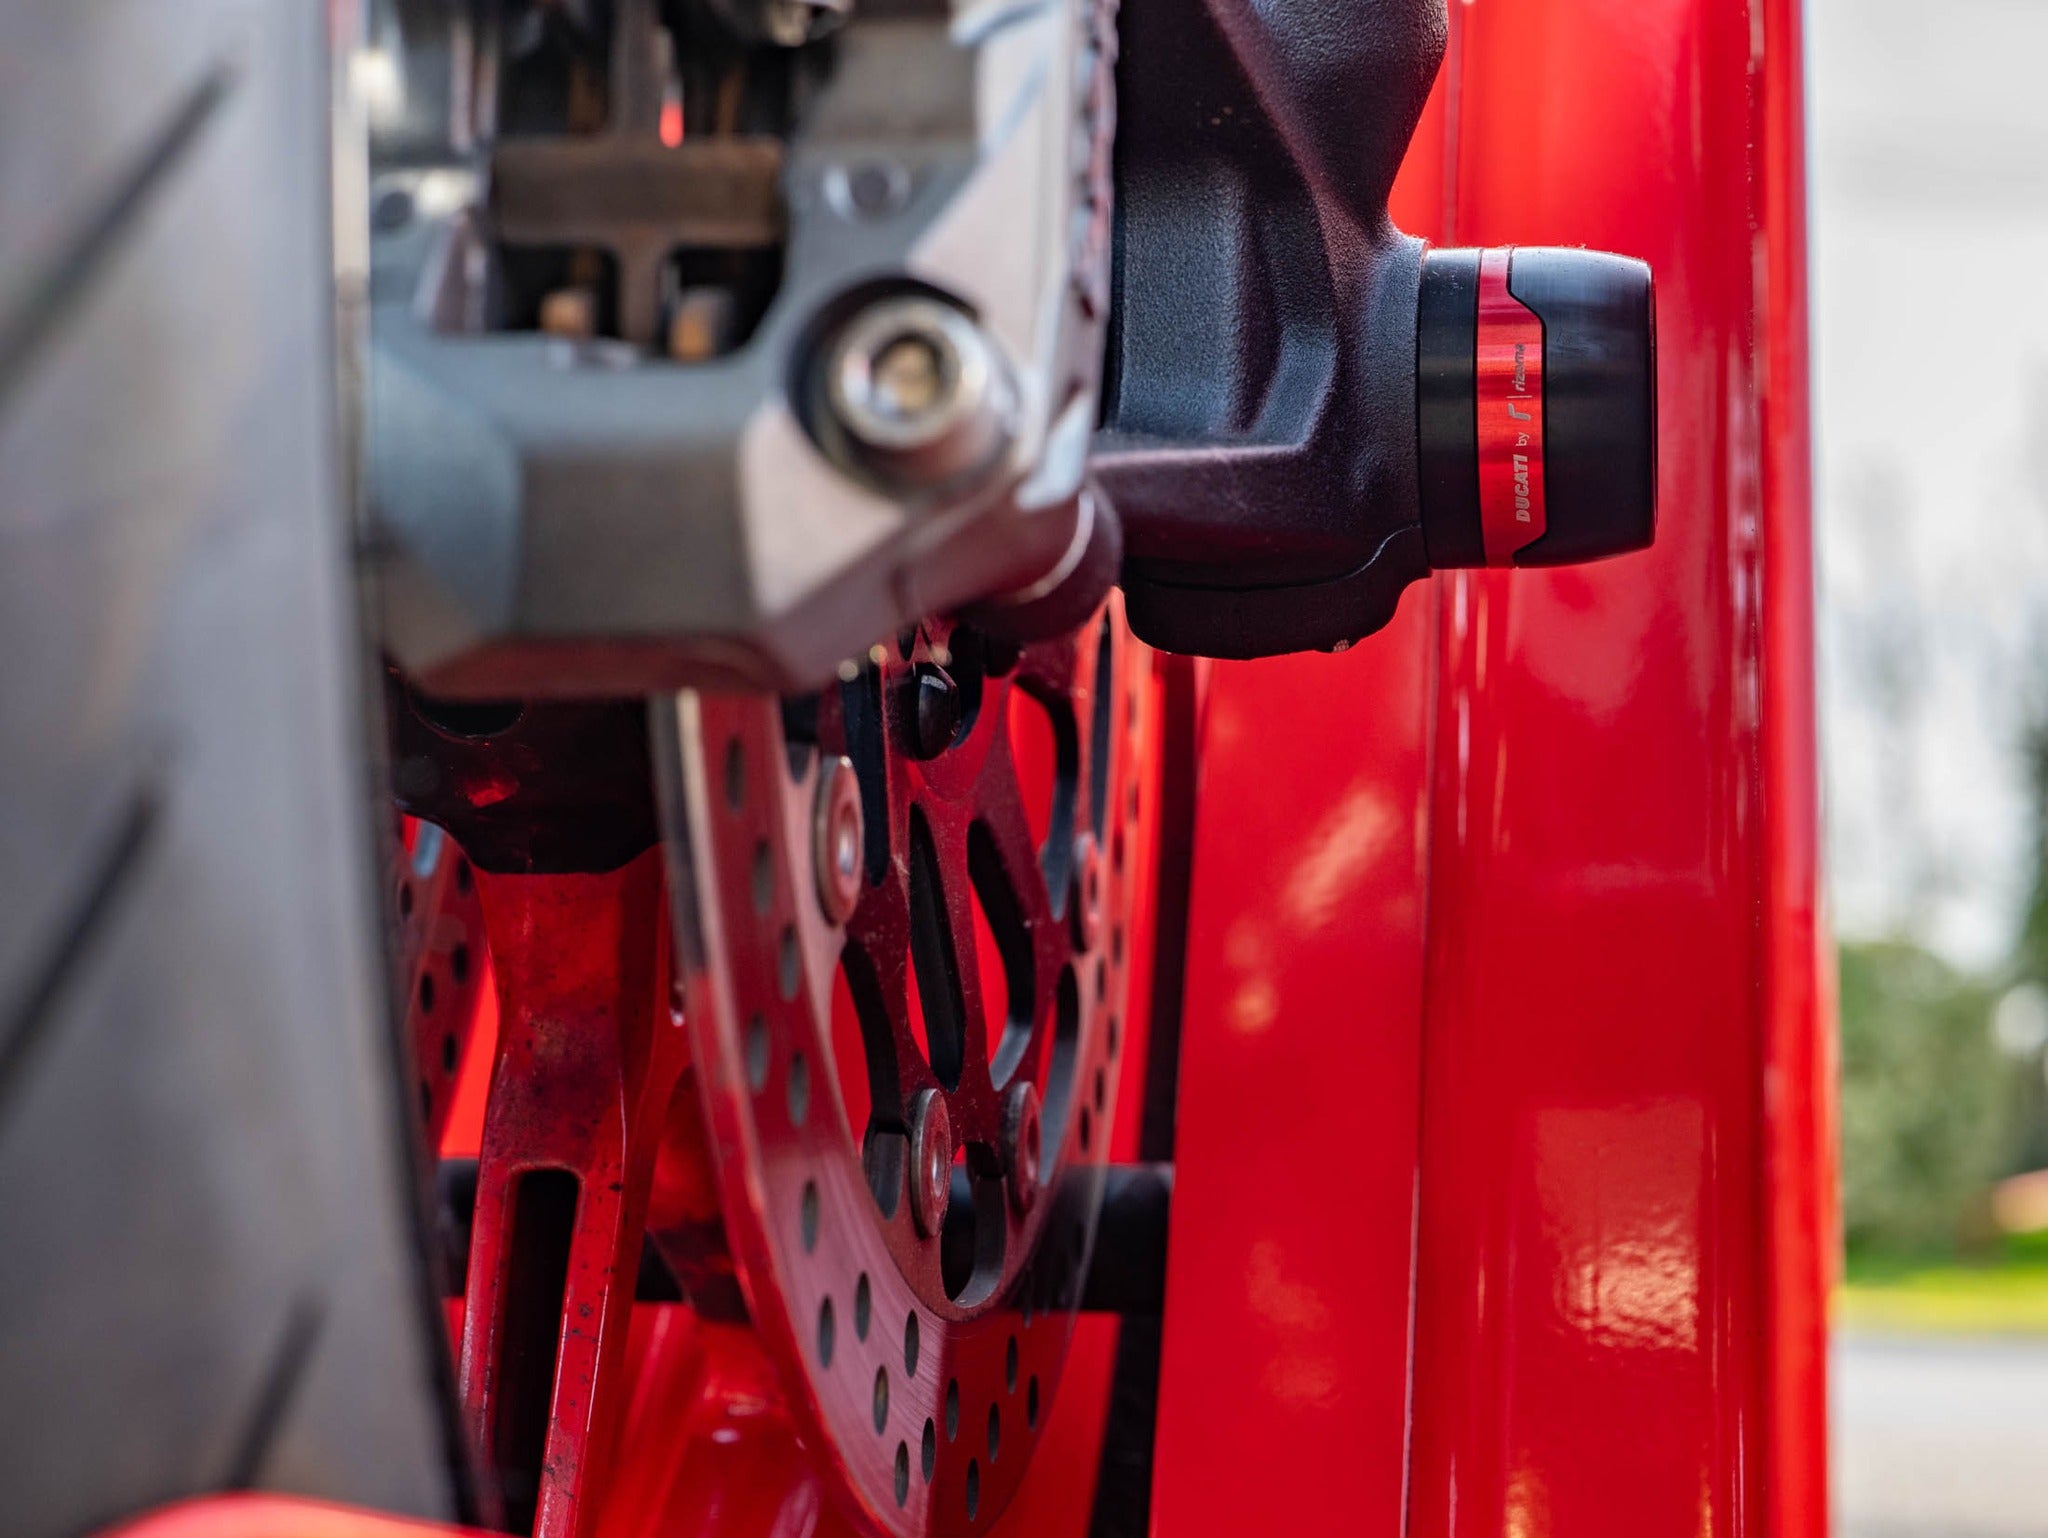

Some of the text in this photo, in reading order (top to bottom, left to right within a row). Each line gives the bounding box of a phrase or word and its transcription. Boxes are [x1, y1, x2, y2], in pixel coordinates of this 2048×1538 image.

[1512, 344, 1526, 392] rizoma
[1516, 432, 1530, 447] by
[1513, 455, 1531, 523] DUCATI
